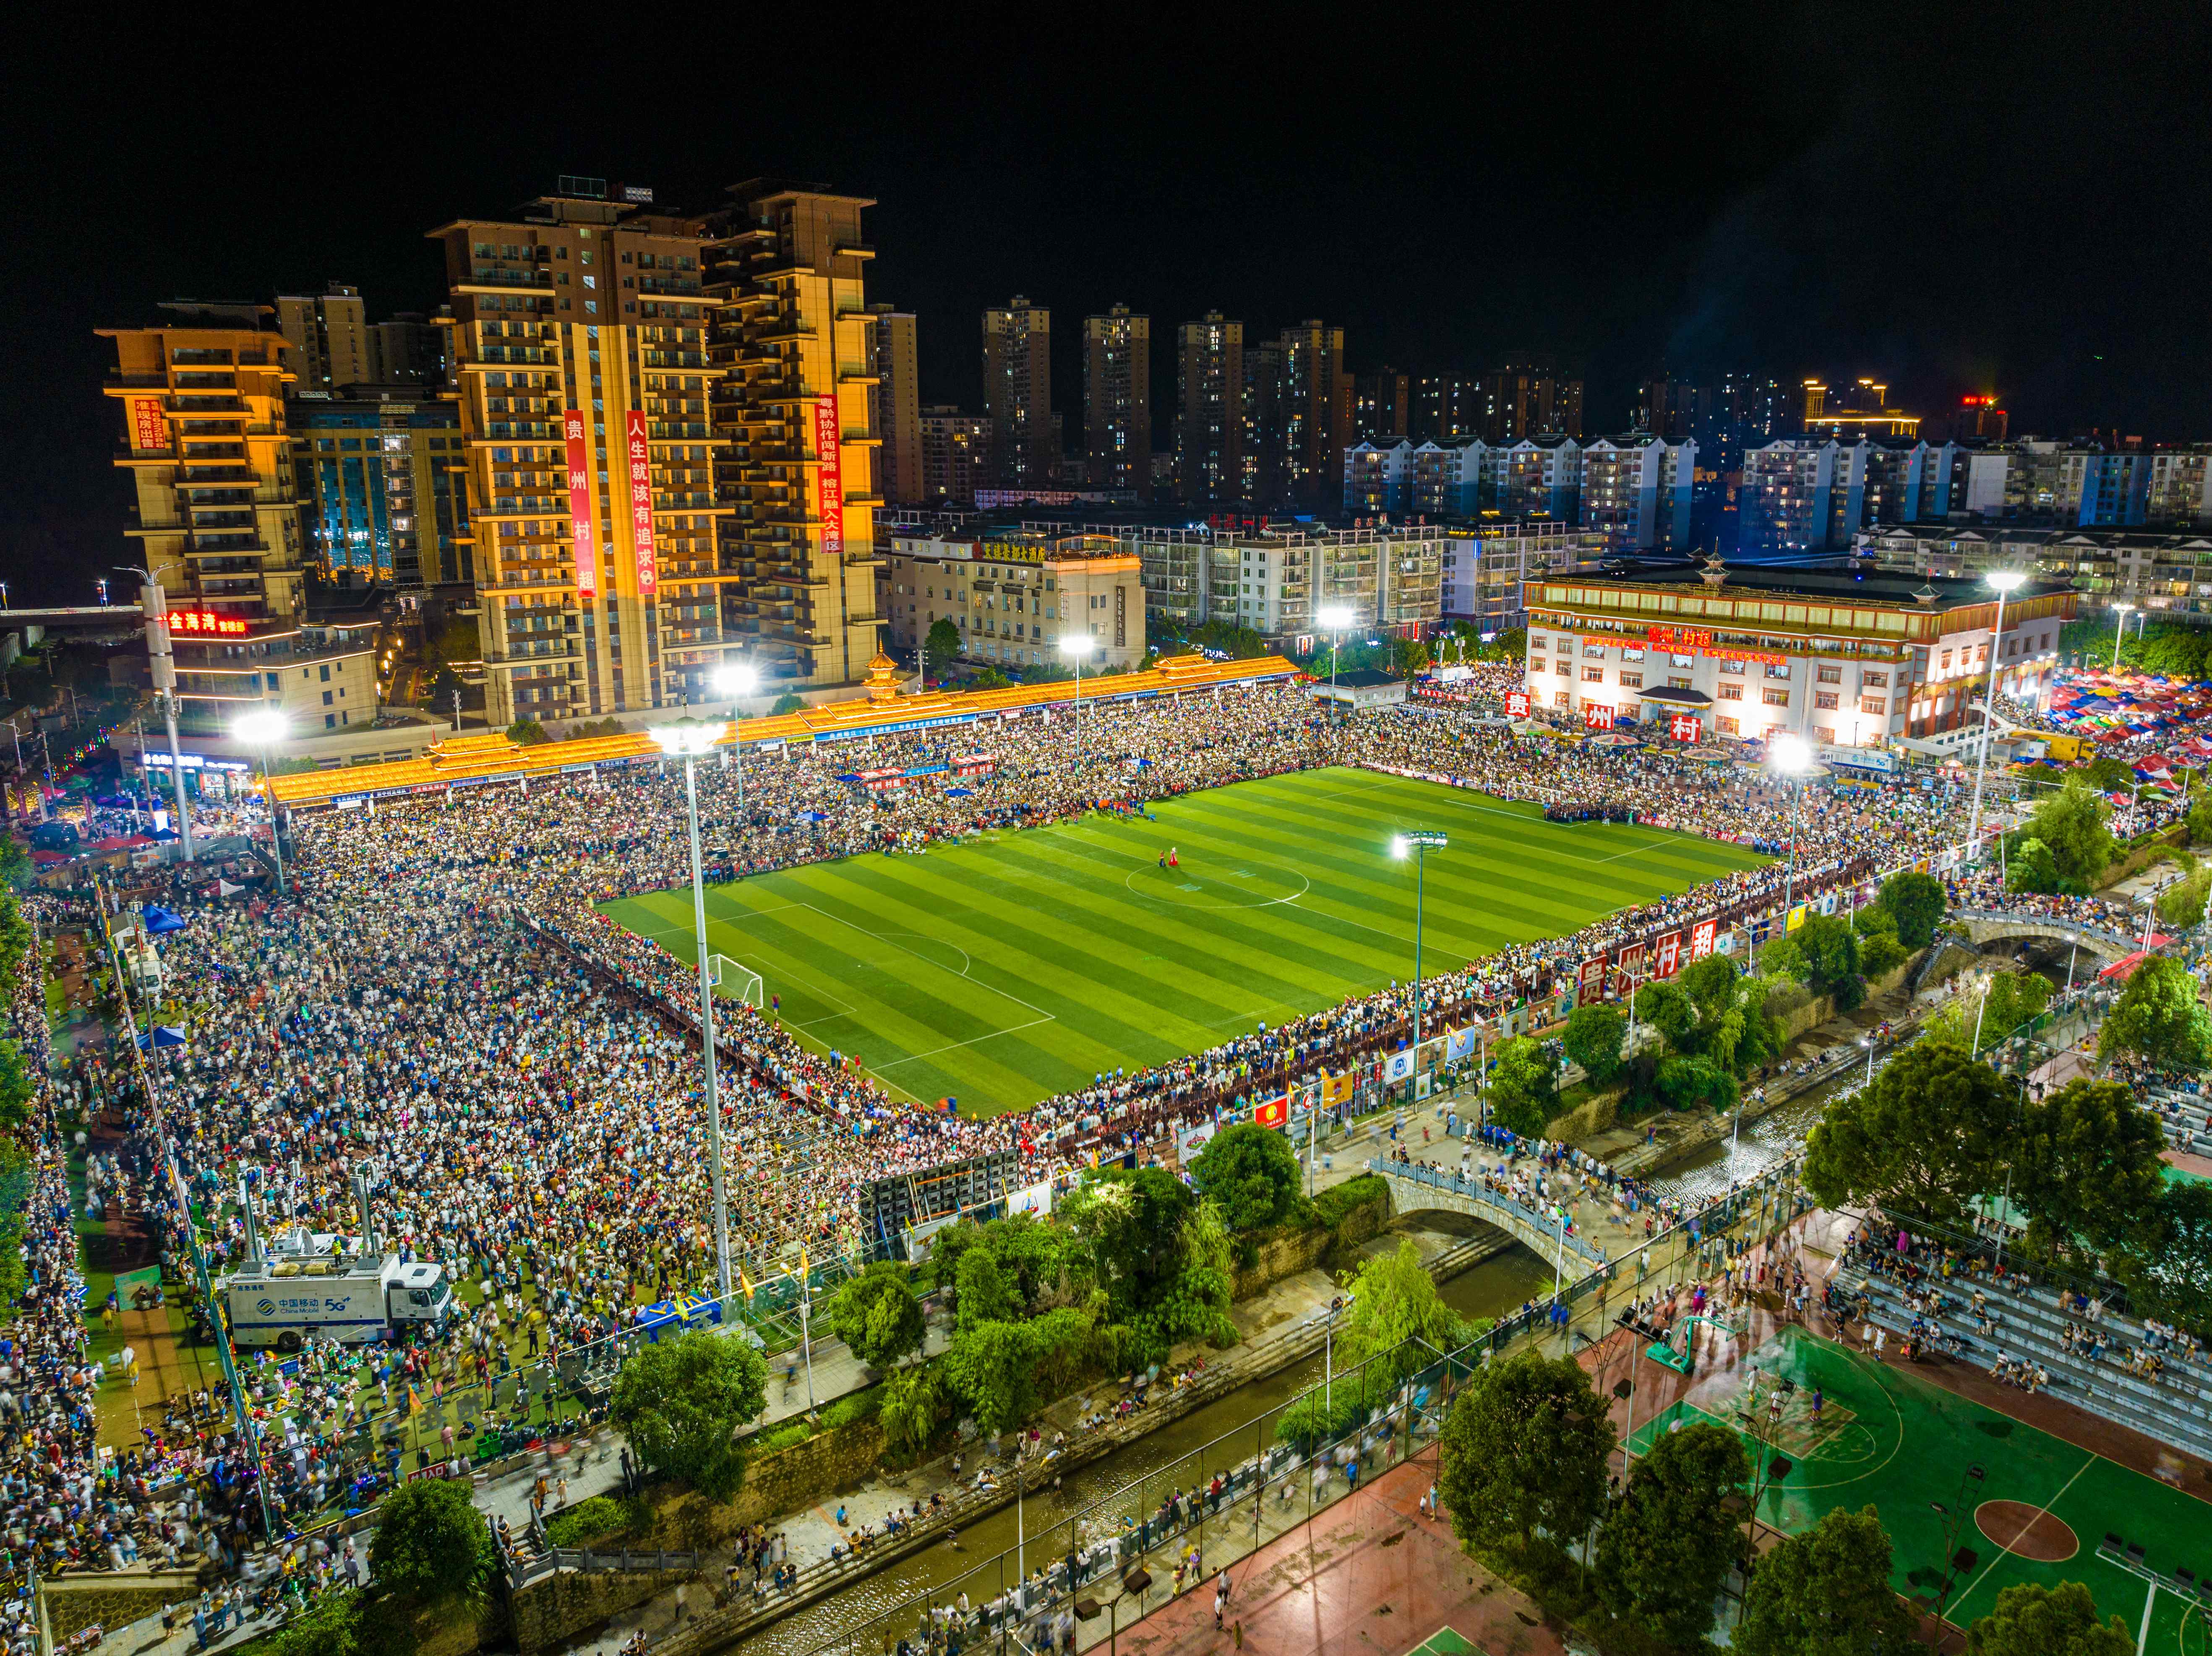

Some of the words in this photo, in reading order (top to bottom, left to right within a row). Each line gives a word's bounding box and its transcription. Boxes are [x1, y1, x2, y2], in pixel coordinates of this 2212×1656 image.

[136, 401, 154, 448] 准现房出售
[819, 398, 837, 472] 粤黔协作闯新路
[567, 420, 595, 588] 贵州村超
[629, 418, 653, 566] 人生就该有追求
[822, 478, 840, 551] 榕江融入大湾区
[1682, 630, 1711, 647] 村超
[1508, 695, 1529, 716] 贵
[1589, 705, 1612, 729] 州
[1672, 716, 1699, 742] 村
[1581, 962, 1604, 1005] 贵
[1621, 946, 1643, 988] 州
[1657, 934, 1680, 977] 村
[1693, 923, 1714, 961] 超
[279, 1298, 318, 1307] 中国移动
